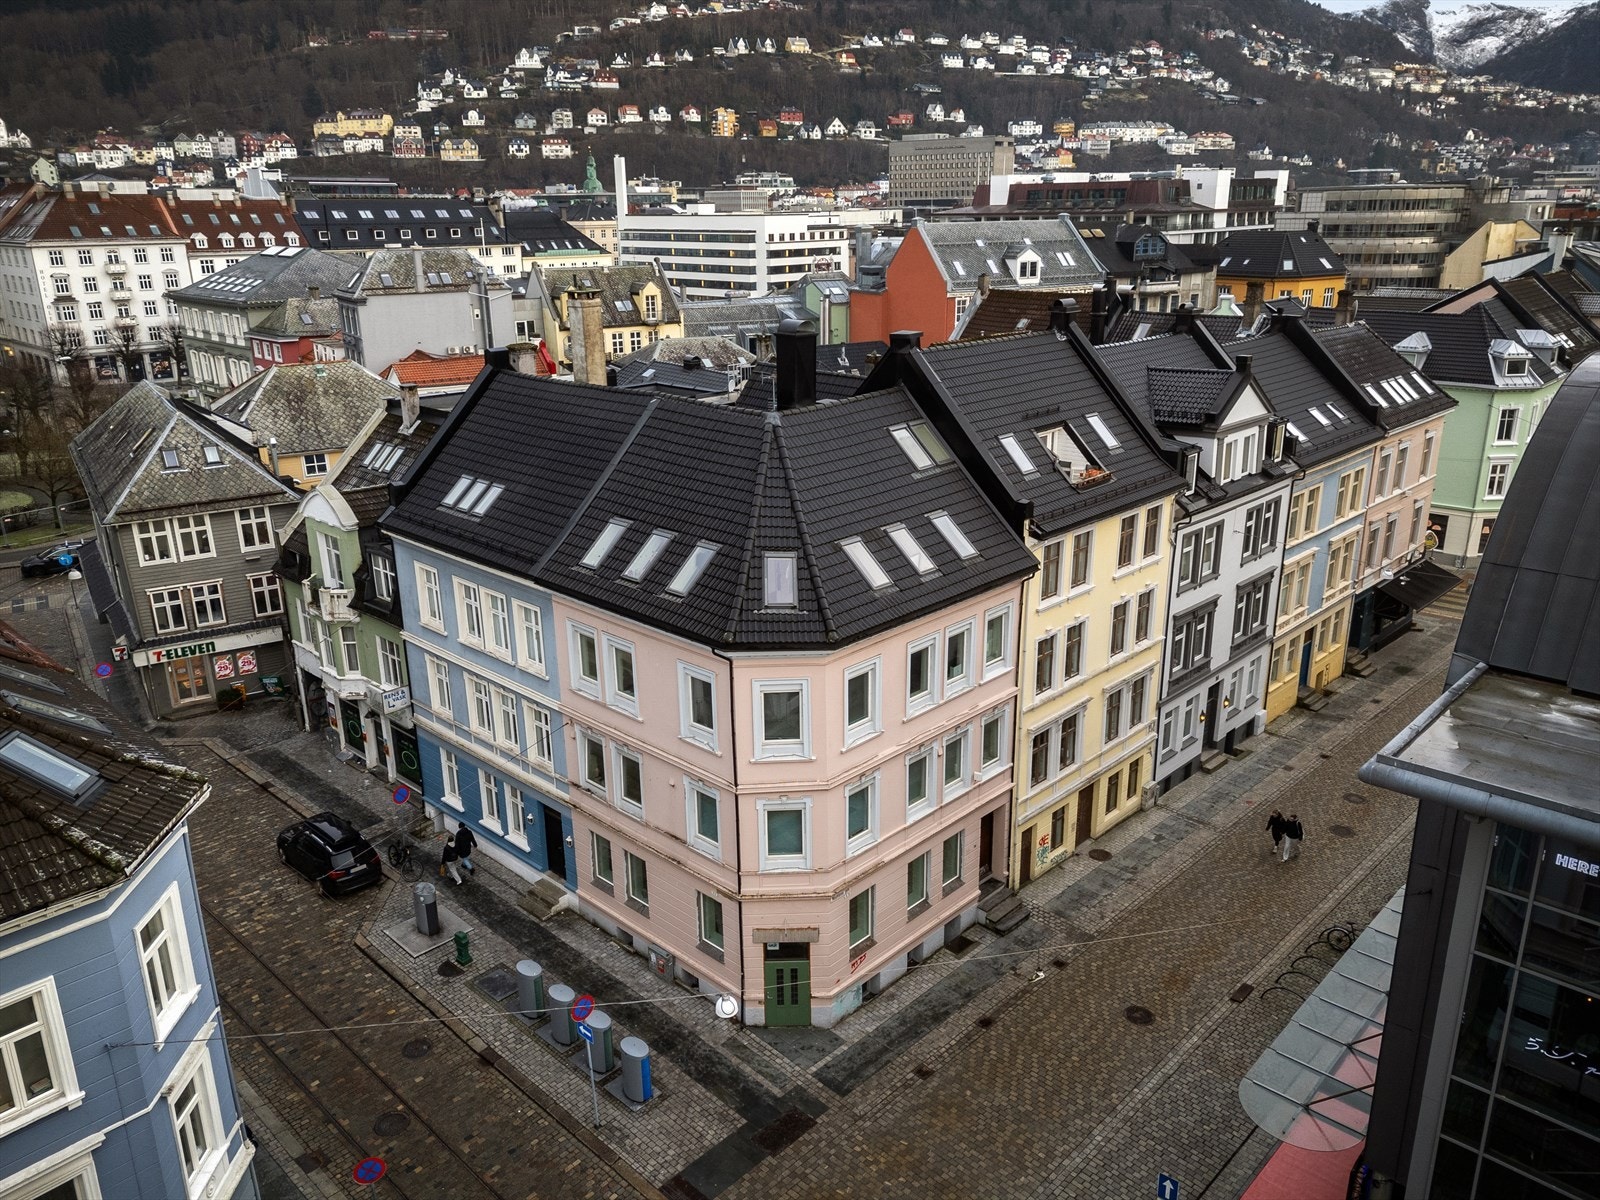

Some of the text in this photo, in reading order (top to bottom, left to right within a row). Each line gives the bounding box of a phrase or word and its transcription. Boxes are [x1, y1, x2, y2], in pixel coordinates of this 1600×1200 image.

[39, 270, 48, 298] HOTEL
[384, 691, 400, 699] RENS
[392, 694, 406, 702] VASK
